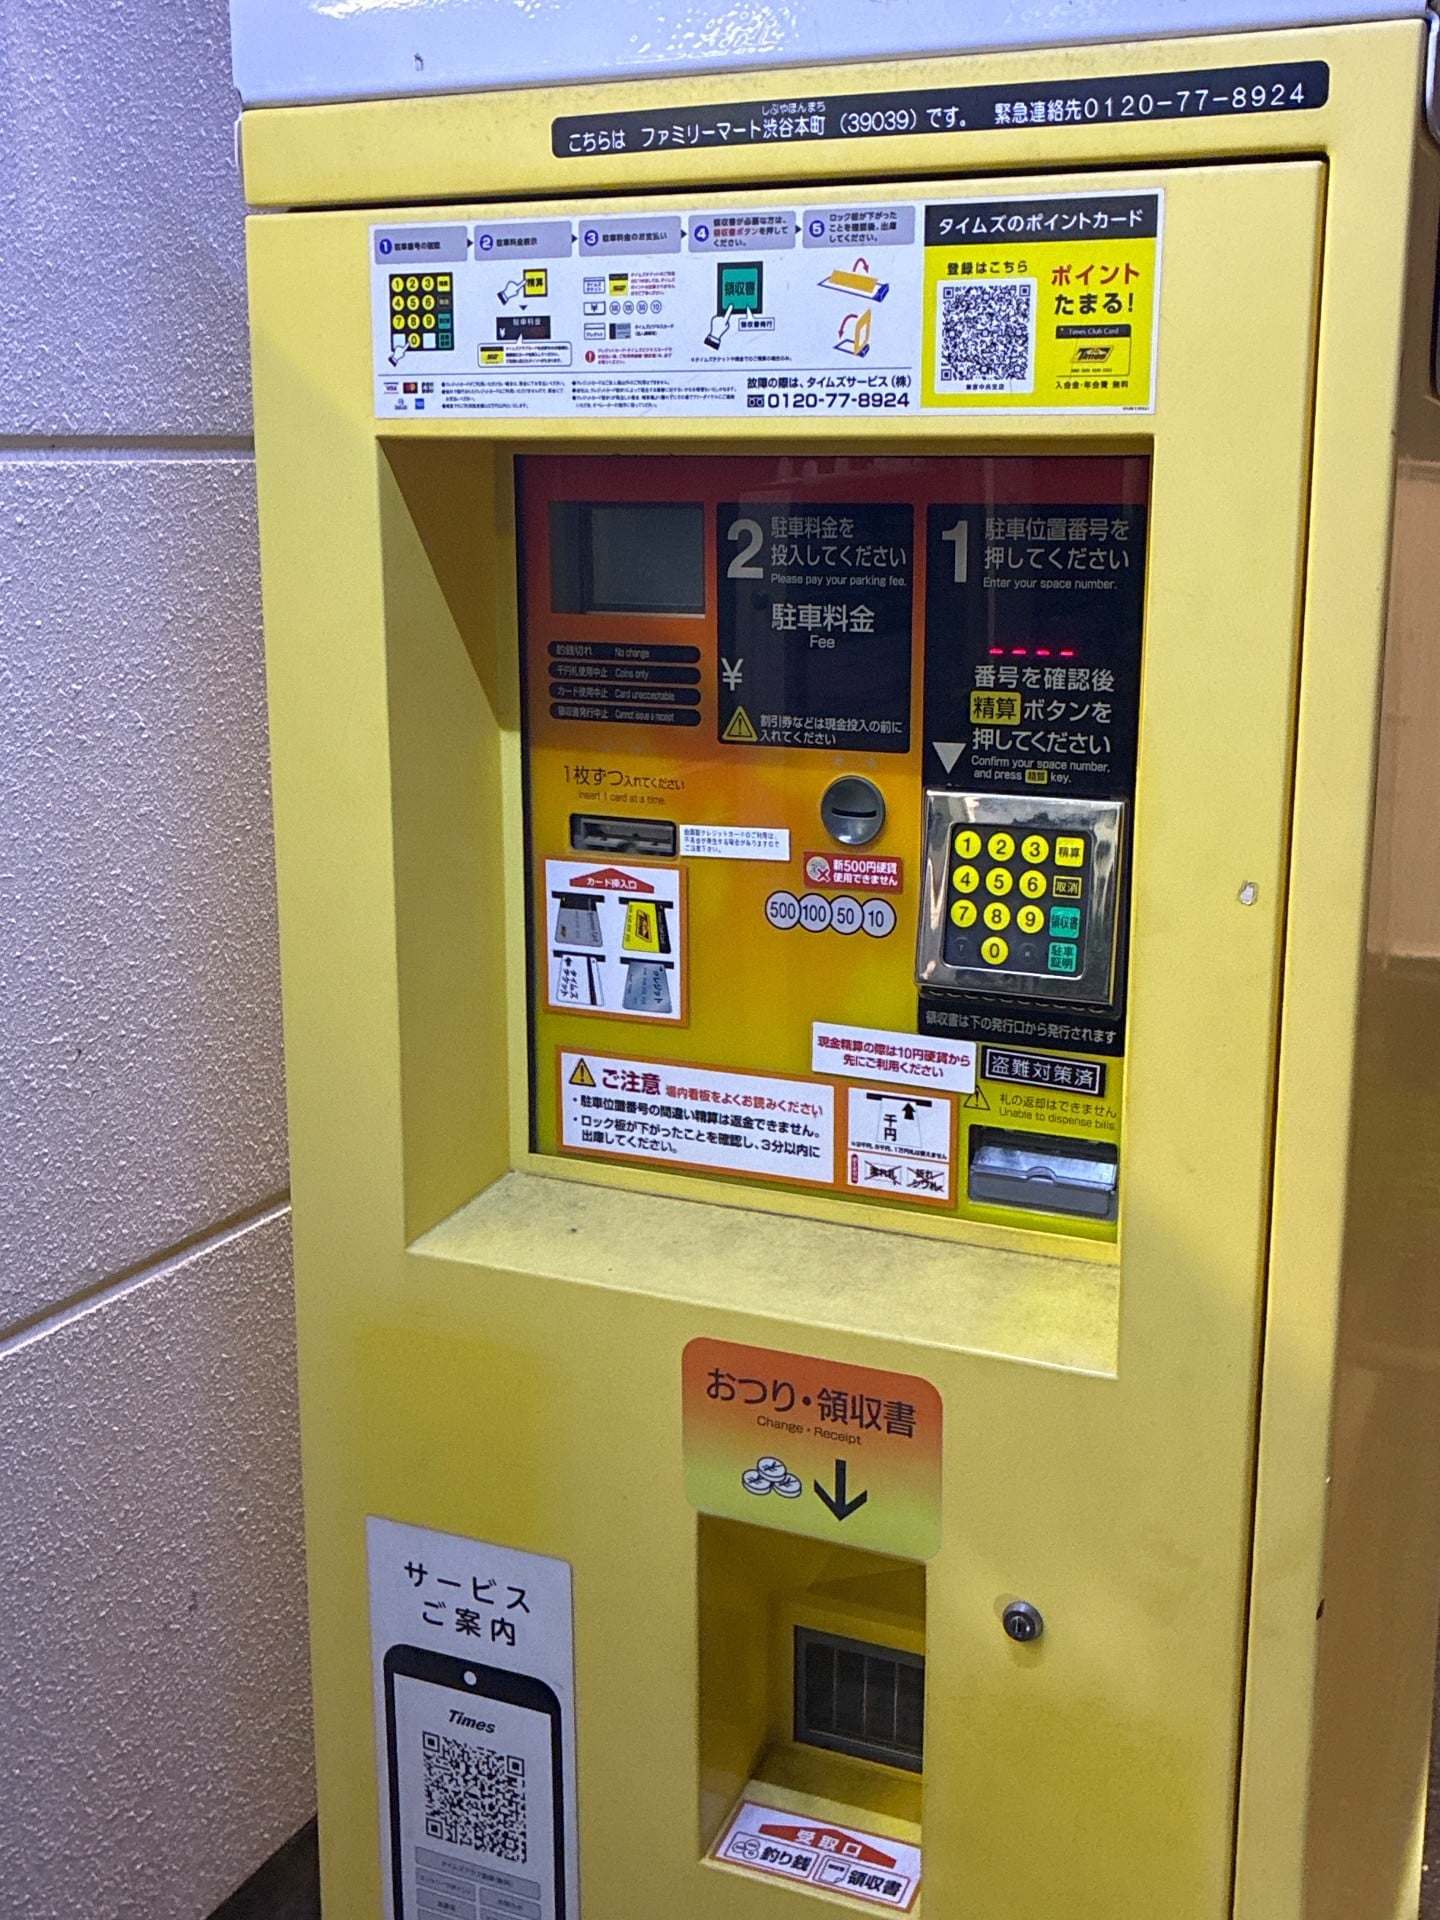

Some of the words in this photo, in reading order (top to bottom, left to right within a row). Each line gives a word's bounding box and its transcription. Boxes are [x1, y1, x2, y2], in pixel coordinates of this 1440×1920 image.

[762, 101, 826, 116] しぶやほんまち
[568, 132, 626, 153] こちらは
[829, 212, 898, 222] ロック板が下がった
[938, 209, 1144, 235] タイムズのポイントカード
[696, 227, 708, 240] 4
[713, 226, 789, 237] 領収書ボタンを押して
[812, 222, 822, 235] 5
[482, 237, 491, 248] 2
[587, 232, 596, 244] 3
[602, 232, 668, 243] 駐車料金のお支払い
[713, 238, 748, 247] ください。
[829, 233, 879, 243] してください。
[382, 241, 389, 252] 1
[947, 260, 1028, 276] 登録はこちら
[1051, 262, 1140, 286] ポイント
[724, 281, 756, 296] 領収書
[1104, 327, 1119, 335] Card
[767, 392, 910, 409] 0120-77-8924
[771, 516, 855, 540] 駐車料金を
[985, 517, 1130, 541] 駐車位置番号を
[727, 518, 764, 579] 2
[771, 544, 907, 568] 投入してください
[942, 520, 968, 583] 1
[984, 546, 1129, 570] 押してください
[771, 573, 802, 584] Please
[805, 575, 823, 586] pay
[826, 576, 847, 587] your
[850, 575, 887, 587] parking
[983, 577, 1011, 588] Enter
[1014, 578, 1036, 590] your
[1040, 579, 1072, 590] space
[1074, 579, 1118, 590] number.
[771, 603, 875, 633] 駐車料金
[810, 635, 835, 648] Fee
[615, 668, 634, 678] Coins
[635, 669, 650, 680] only
[721, 657, 744, 691] ¥
[974, 665, 1115, 692] 番号を確認後
[615, 689, 631, 699] Card
[973, 696, 1017, 720] 精算
[1024, 699, 1112, 724] ボタンを
[760, 714, 903, 735] 割引券などは現金投入の前に
[760, 731, 836, 745] 入れてください
[972, 728, 1111, 754] 押してください
[971, 755, 1010, 767] Confirm
[1012, 758, 1033, 769] your
[1037, 760, 1067, 770] space
[974, 769, 992, 779] and
[994, 771, 1022, 782] press
[1050, 772, 1072, 783] key.
[963, 837, 971, 853] 1
[995, 839, 1006, 855] 2
[1029, 842, 1041, 857] 3
[1058, 846, 1081, 858] 精算
[833, 858, 898, 875] 新500円硬貨
[833, 871, 898, 886] 使用できません
[960, 872, 970, 887] 4
[993, 874, 1004, 890] 5
[1027, 876, 1038, 892] 6
[1055, 881, 1078, 894] 取消
[770, 901, 796, 919] 500
[802, 904, 827, 922] 100
[836, 907, 855, 925] 50
[959, 906, 969, 921] 7
[991, 908, 1002, 924] 8
[868, 910, 885, 928] 10
[1025, 911, 1036, 927] 9
[1051, 915, 1079, 931] 領収書
[989, 943, 1000, 959] 0
[1050, 945, 1073, 962] 駐車
[1050, 961, 1074, 974] 証明
[926, 1010, 1117, 1045] 領収書は下の発行口から発行されます
[817, 1035, 971, 1067] 現金精算の際は10円硬貨から
[843, 1054, 944, 1078] 先にご利用ください
[991, 1056, 1095, 1089] 盗難対策済
[602, 1067, 661, 1096] ご注意
[666, 1085, 824, 1119] 場内看板をよくお読みください
[1000, 1092, 1117, 1119] 札の返却はできません
[1000, 1109, 1033, 1121] Unable
[1035, 1112, 1045, 1122] to
[1048, 1113, 1093, 1127] dispense
[581, 1130, 679, 1155] 出庫してください。
[706, 1367, 916, 1439] おつり・領収書
[404, 1561, 530, 1613] サービス
[422, 1601, 516, 1646] ご案内
[449, 1709, 496, 1733] Times
[796, 1829, 863, 1858] 受取口
[761, 1846, 813, 1872] 釣り銭
[848, 1869, 902, 1898] 領収書
